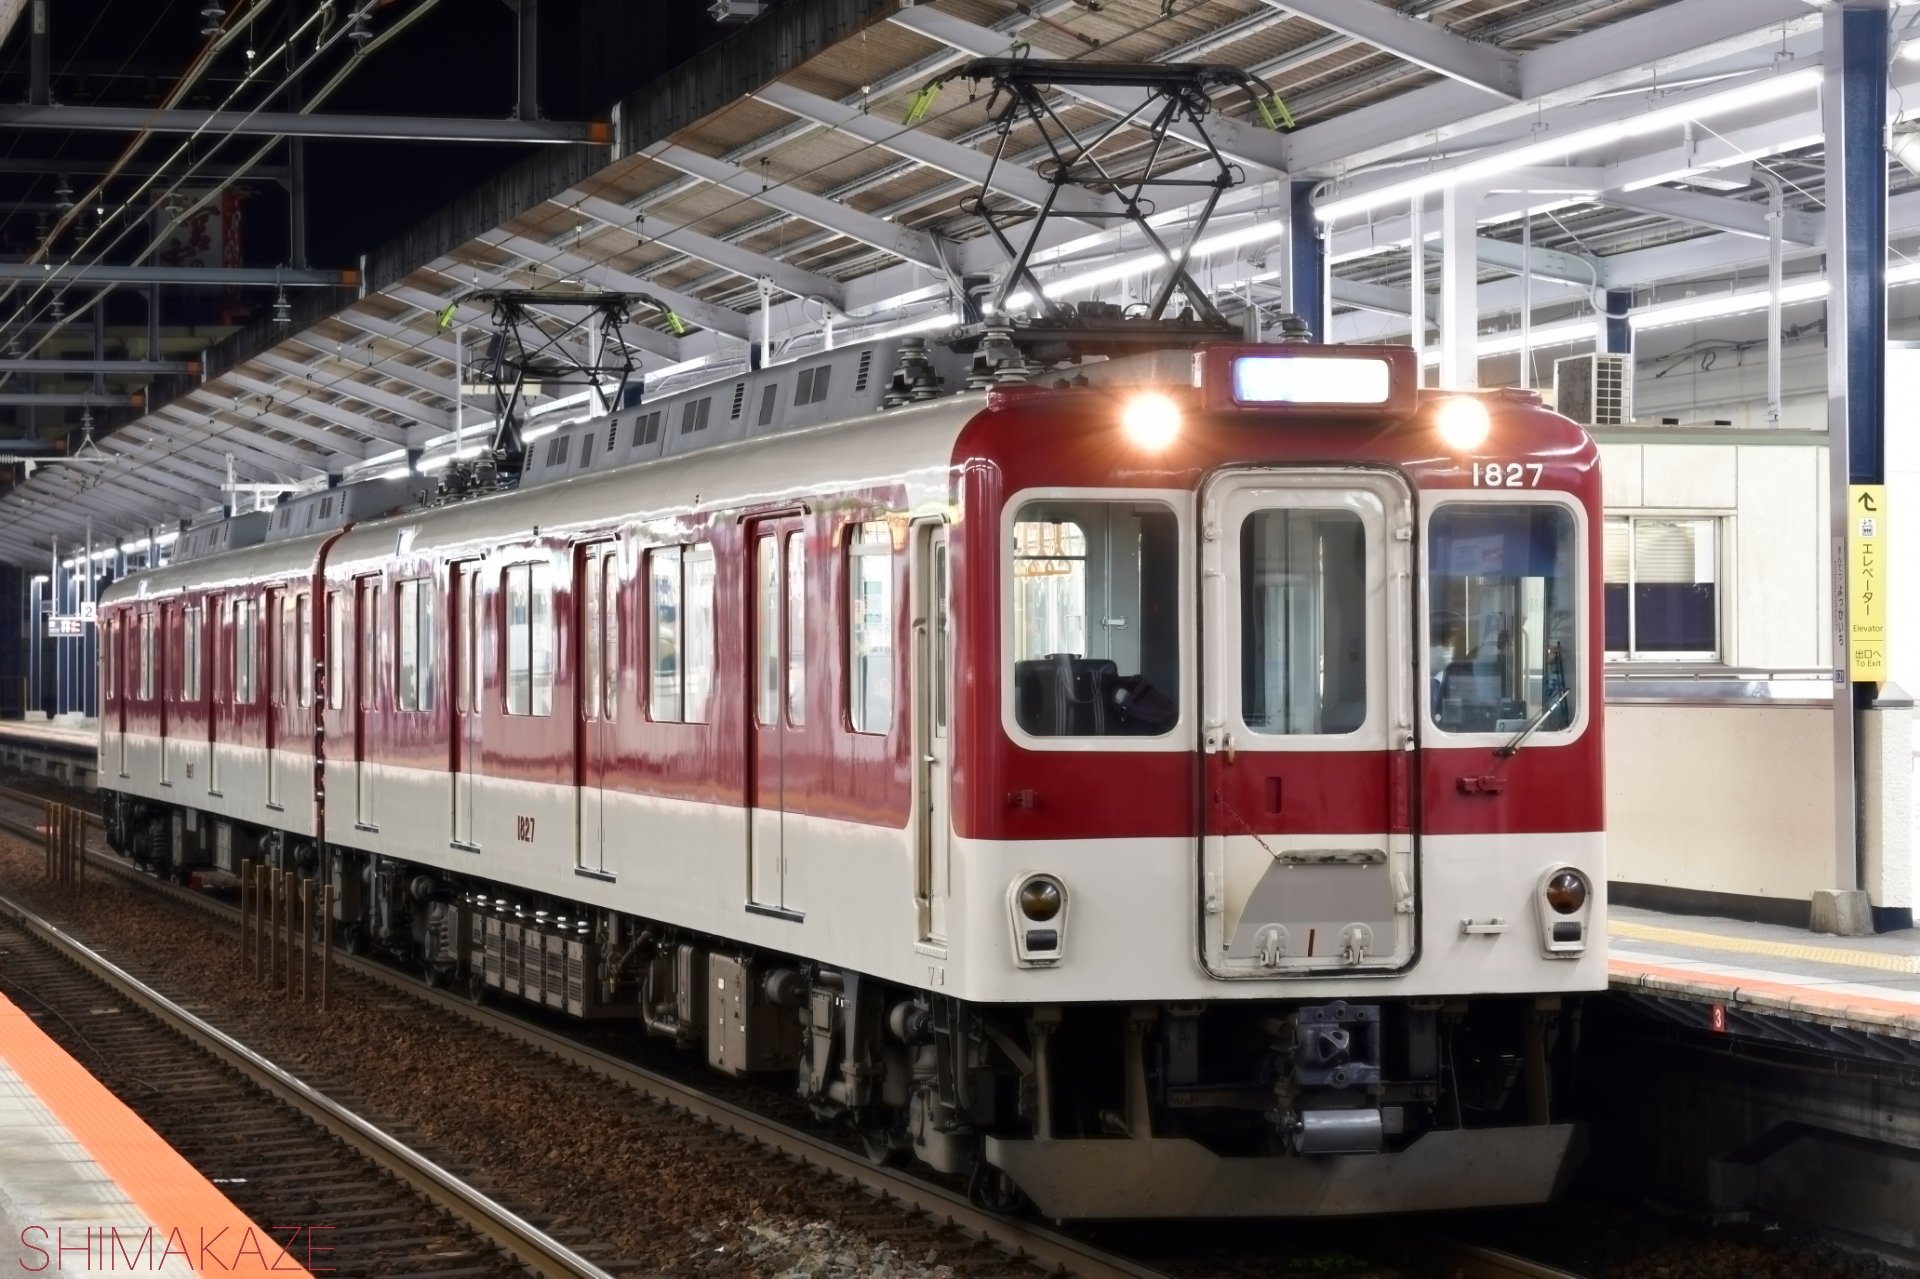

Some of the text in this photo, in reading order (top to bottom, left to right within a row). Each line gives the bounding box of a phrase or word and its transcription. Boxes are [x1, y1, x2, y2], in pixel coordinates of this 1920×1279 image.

[1472, 462, 1543, 487] 1827
[1862, 543, 1874, 616] エレベーター
[85, 606, 93, 618] 2
[1853, 624, 1883, 632] Elevator
[1855, 649, 1882, 659] 出口へ
[517, 815, 535, 843] 1827
[1715, 1008, 1722, 1028] 3
